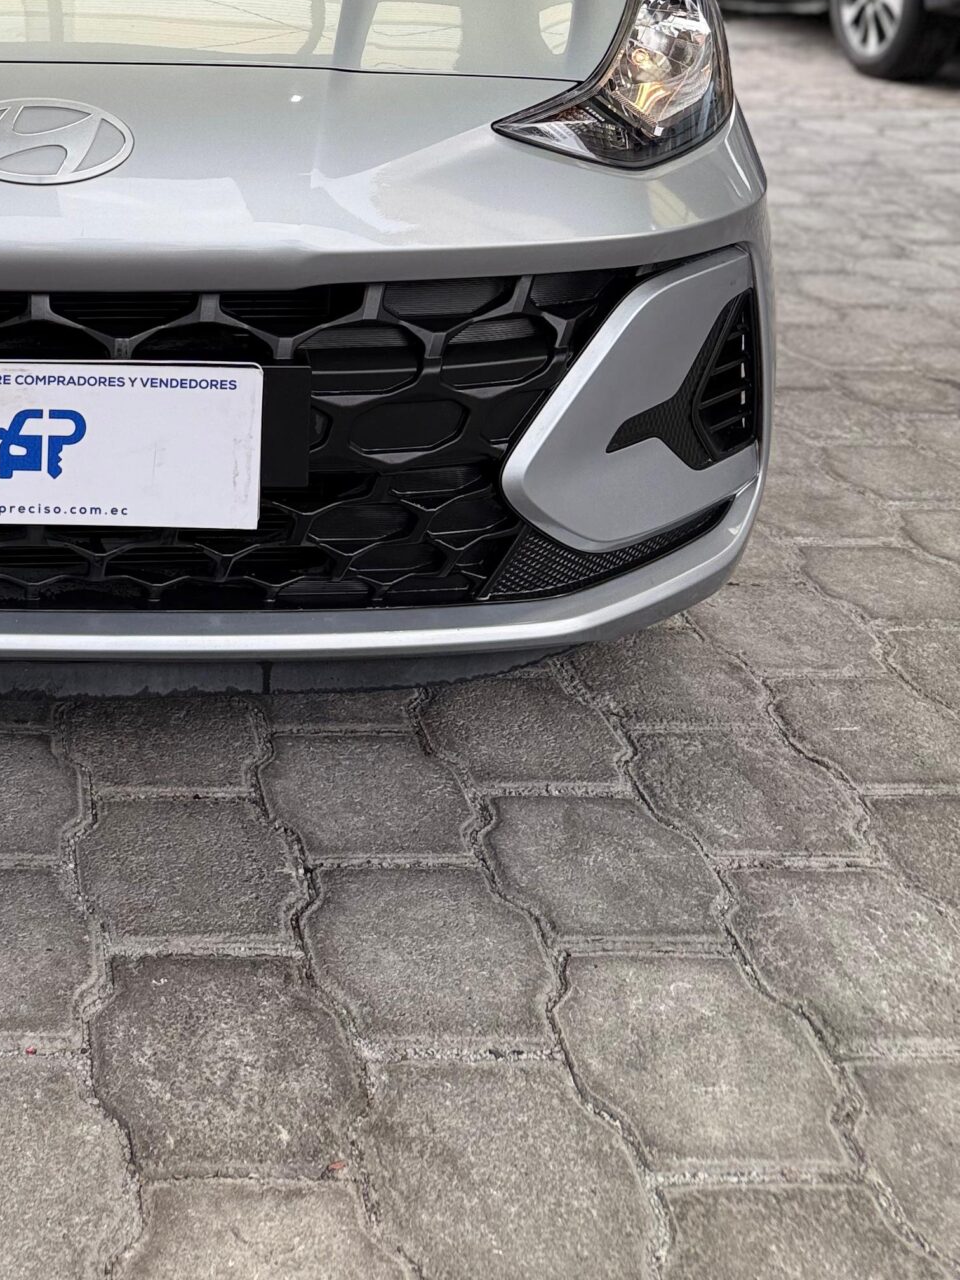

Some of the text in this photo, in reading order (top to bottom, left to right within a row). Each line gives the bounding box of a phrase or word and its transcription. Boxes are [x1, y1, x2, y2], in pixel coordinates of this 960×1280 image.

[14, 374, 126, 388] COMPRADORES
[128, 377, 138, 388] Y
[140, 377, 238, 391] VENDEDORES
